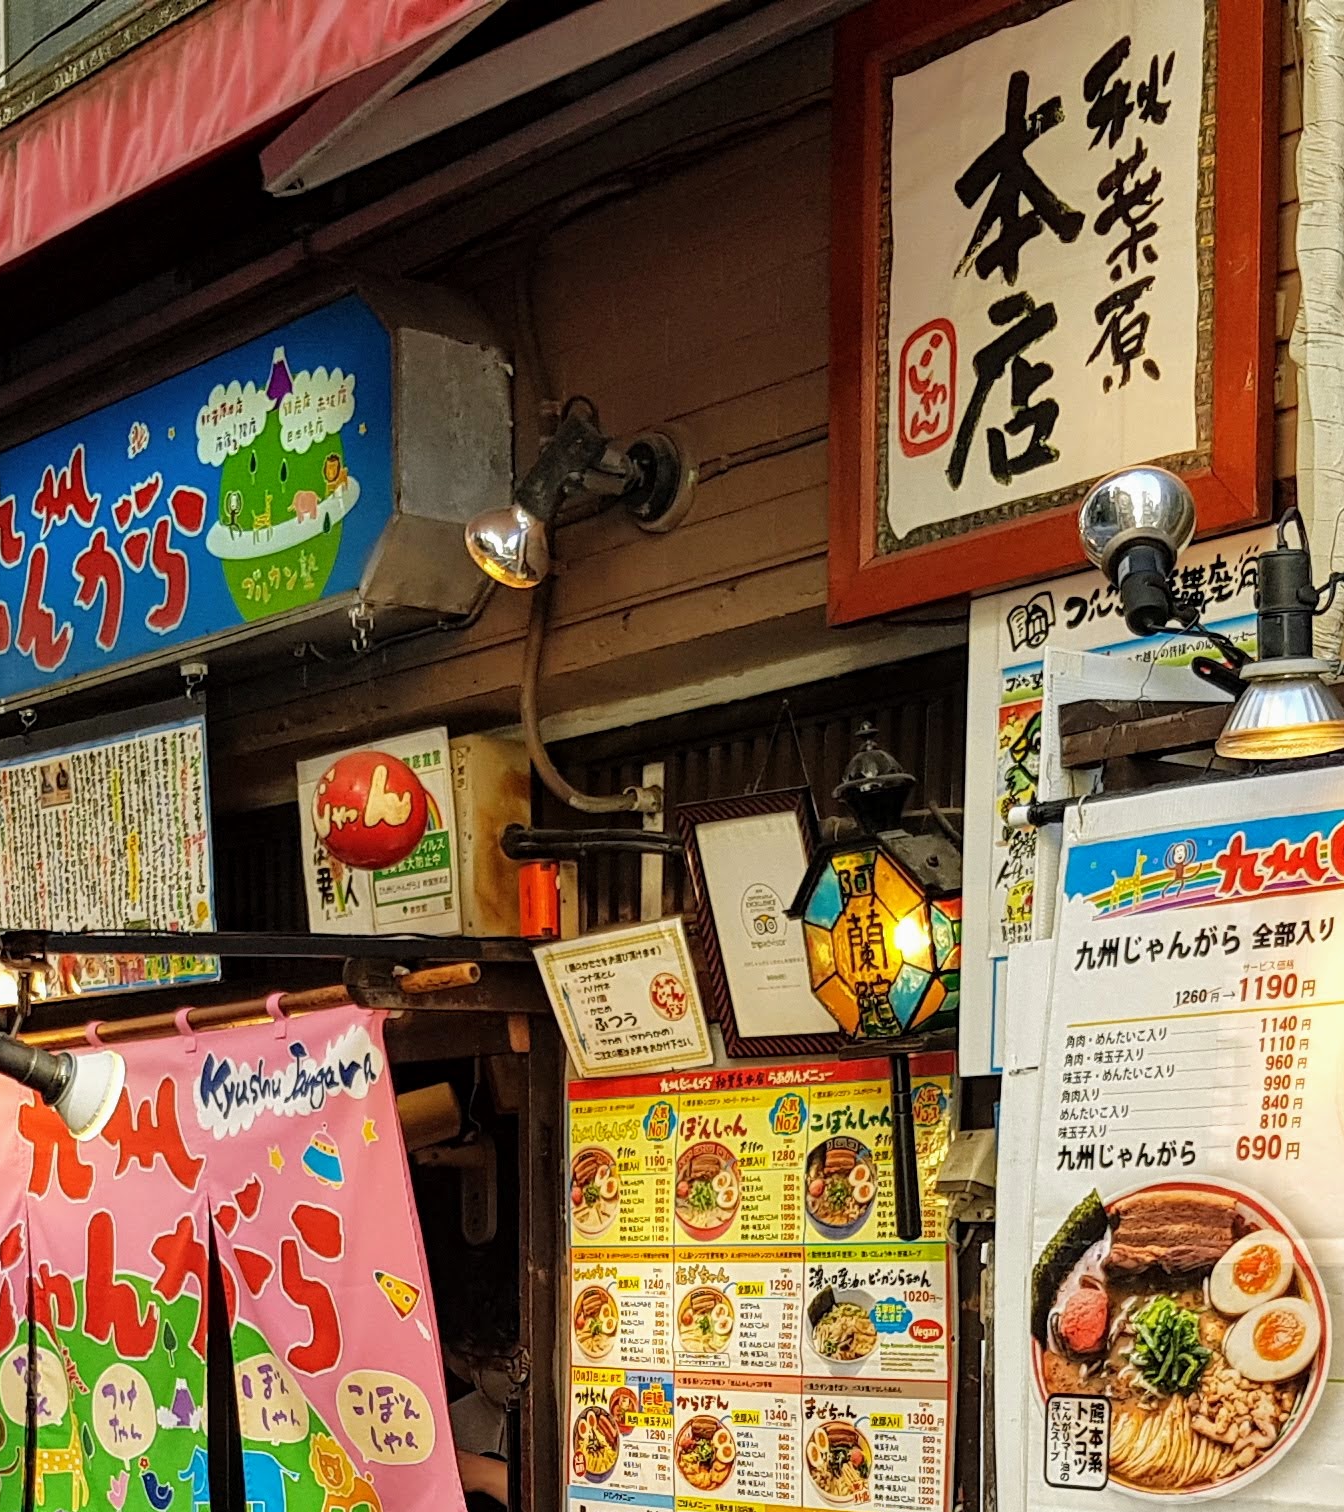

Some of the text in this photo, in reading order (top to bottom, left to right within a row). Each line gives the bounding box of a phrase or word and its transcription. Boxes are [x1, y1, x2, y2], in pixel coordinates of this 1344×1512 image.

[1084, 36, 1174, 392] 秋葉原
[946, 70, 1084, 490] 本店
[313, 765, 412, 839] じゃん
[1074, 917, 1335, 972] 九州じゃんがら 全部入り
[595, 1013, 637, 1031] ふつう
[18, 1078, 204, 1200] 九州
[1056, 1140, 1197, 1171] 九州じゃんがら
[912, 1326, 939, 1339] Vegan
